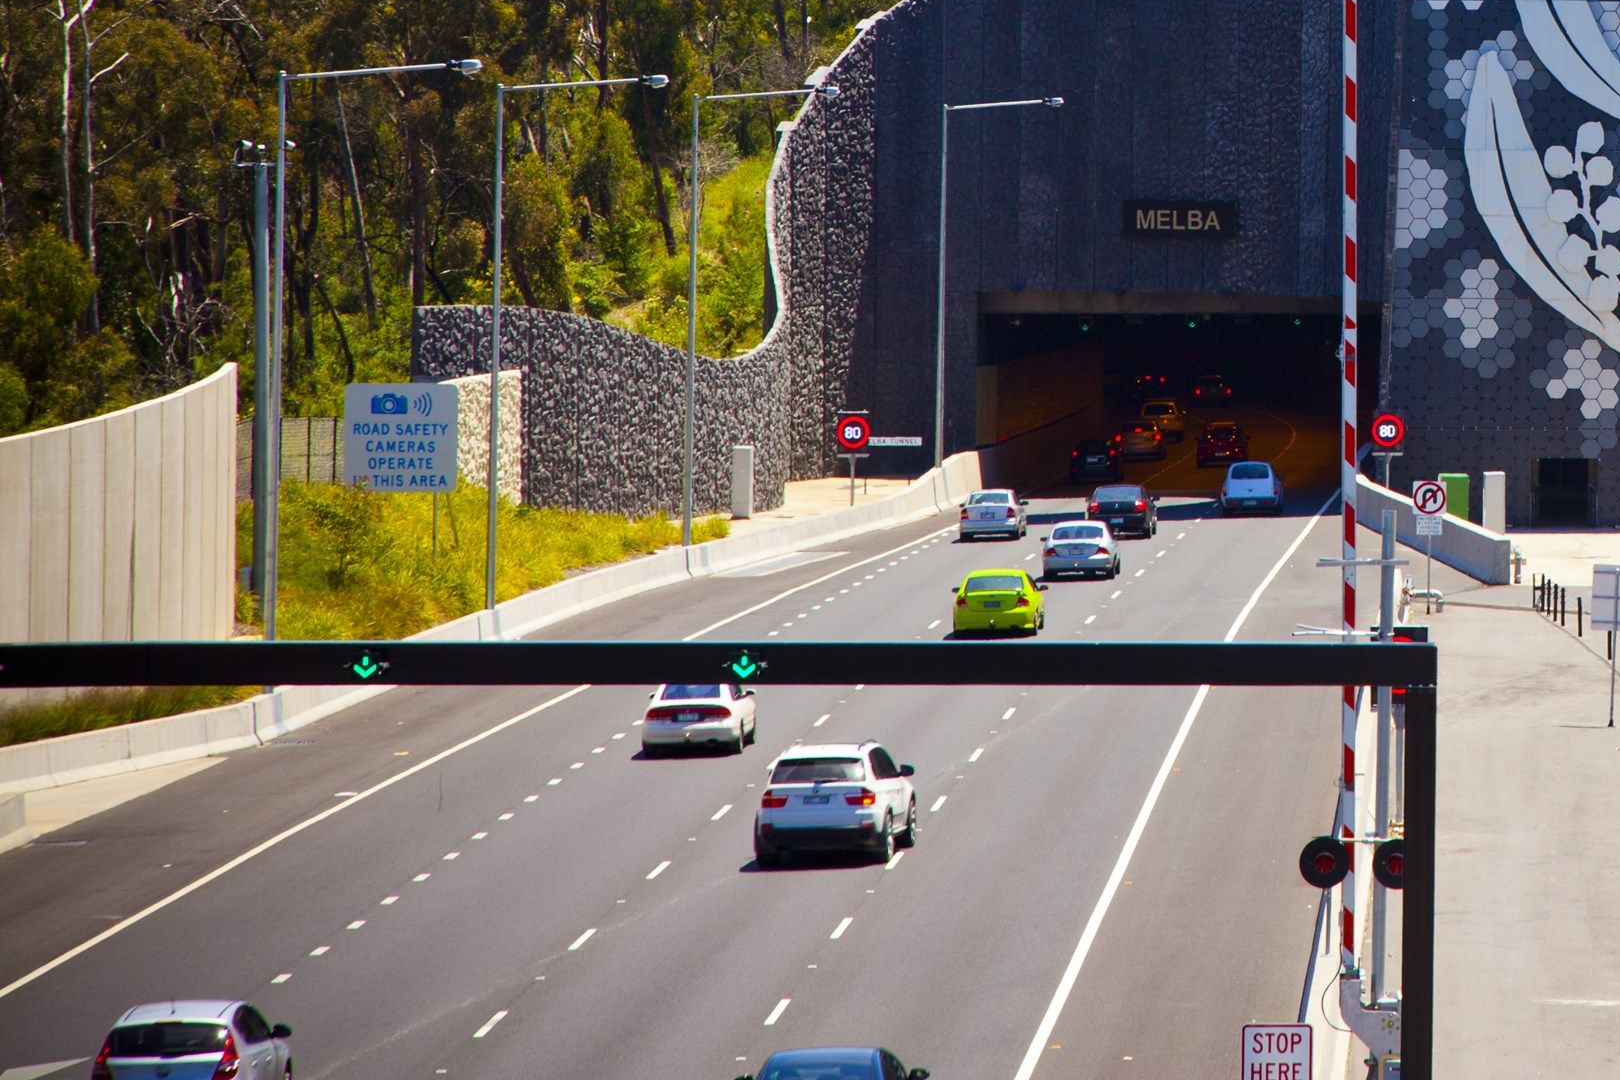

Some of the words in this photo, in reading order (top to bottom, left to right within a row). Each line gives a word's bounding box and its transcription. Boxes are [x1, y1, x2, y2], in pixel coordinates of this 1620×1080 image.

[1136, 209, 1220, 230] MELBA
[352, 423, 390, 435] ROAD
[396, 423, 448, 435] SAFETY
[844, 426, 861, 439] 80
[1379, 425, 1396, 438] 80
[366, 440, 436, 452] CAMERAS
[368, 457, 434, 470] OPERATE
[373, 475, 404, 487] THIS
[409, 475, 447, 487] AREA
[1252, 1032, 1302, 1054] STOP
[1250, 1062, 1303, 1080] HERE
